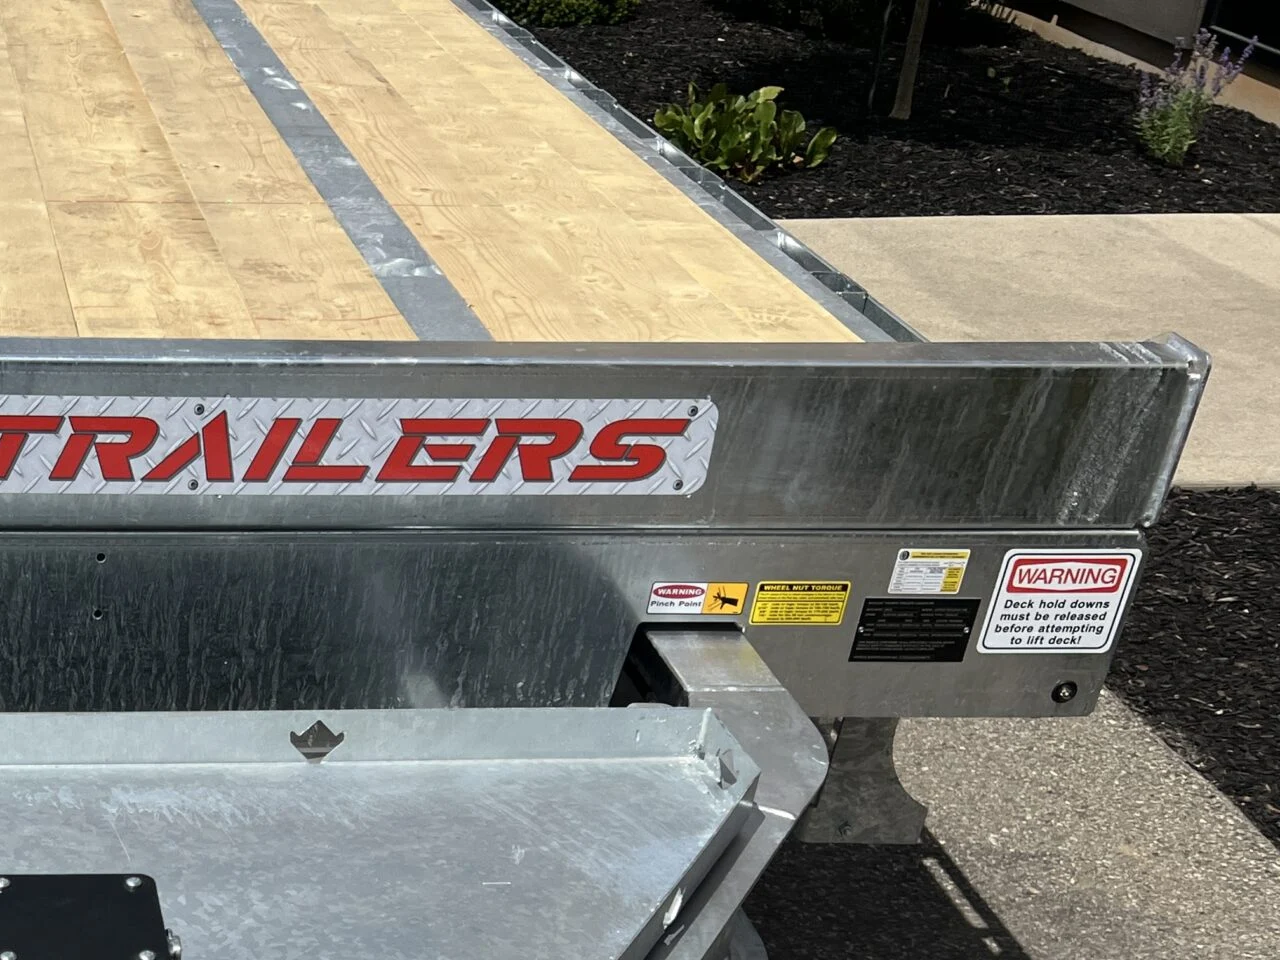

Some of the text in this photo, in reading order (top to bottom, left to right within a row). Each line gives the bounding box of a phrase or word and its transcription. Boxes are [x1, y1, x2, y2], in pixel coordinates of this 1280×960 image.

[1017, 568, 1118, 585] WARNING
[657, 588, 703, 596] WARNING
[1004, 599, 1110, 609] Deck hold downs
[1000, 612, 1107, 621] must be released
[994, 624, 1104, 635] before attempting
[1010, 636, 1082, 645] to lift deck!
